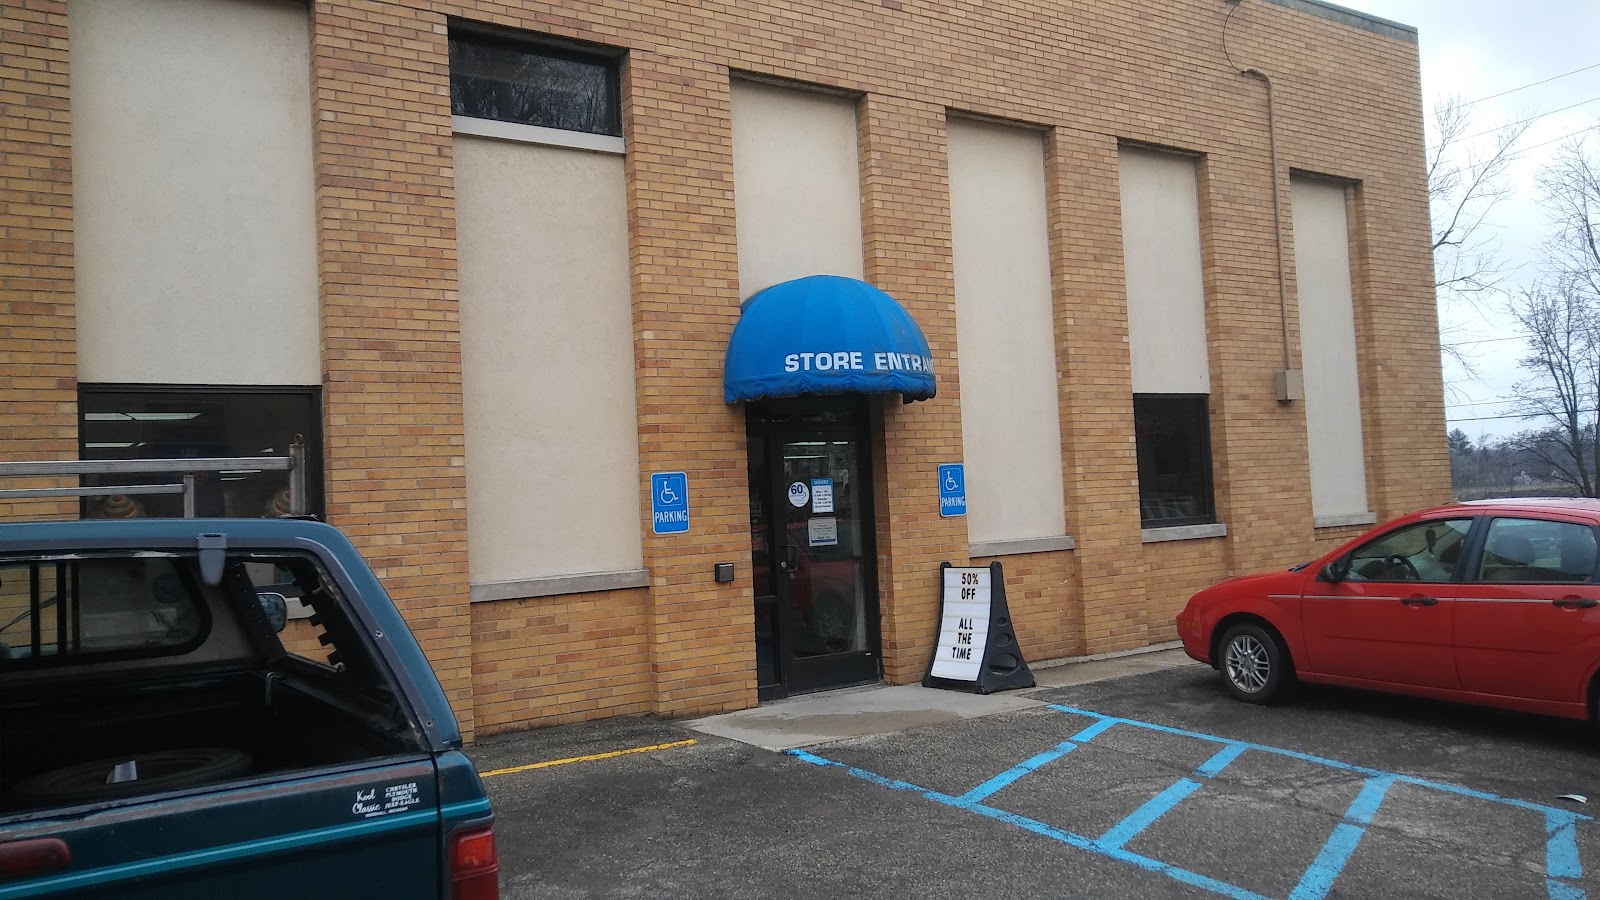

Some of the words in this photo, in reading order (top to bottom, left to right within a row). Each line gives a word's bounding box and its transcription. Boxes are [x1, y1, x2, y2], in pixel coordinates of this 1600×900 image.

[784, 351, 864, 373] STORE
[941, 496, 965, 508] PARKING
[654, 509, 688, 524] PARKING
[961, 573, 979, 585] 50%
[961, 588, 976, 600] OFF
[958, 618, 973, 630] ALL
[957, 632, 973, 645] THE
[952, 647, 972, 660] TIME
[385, 782, 417, 793] CHRYSLER
[385, 787, 418, 799] PLYMOUTH
[391, 794, 412, 802] DODGE
[352, 801, 381, 814] Classic
